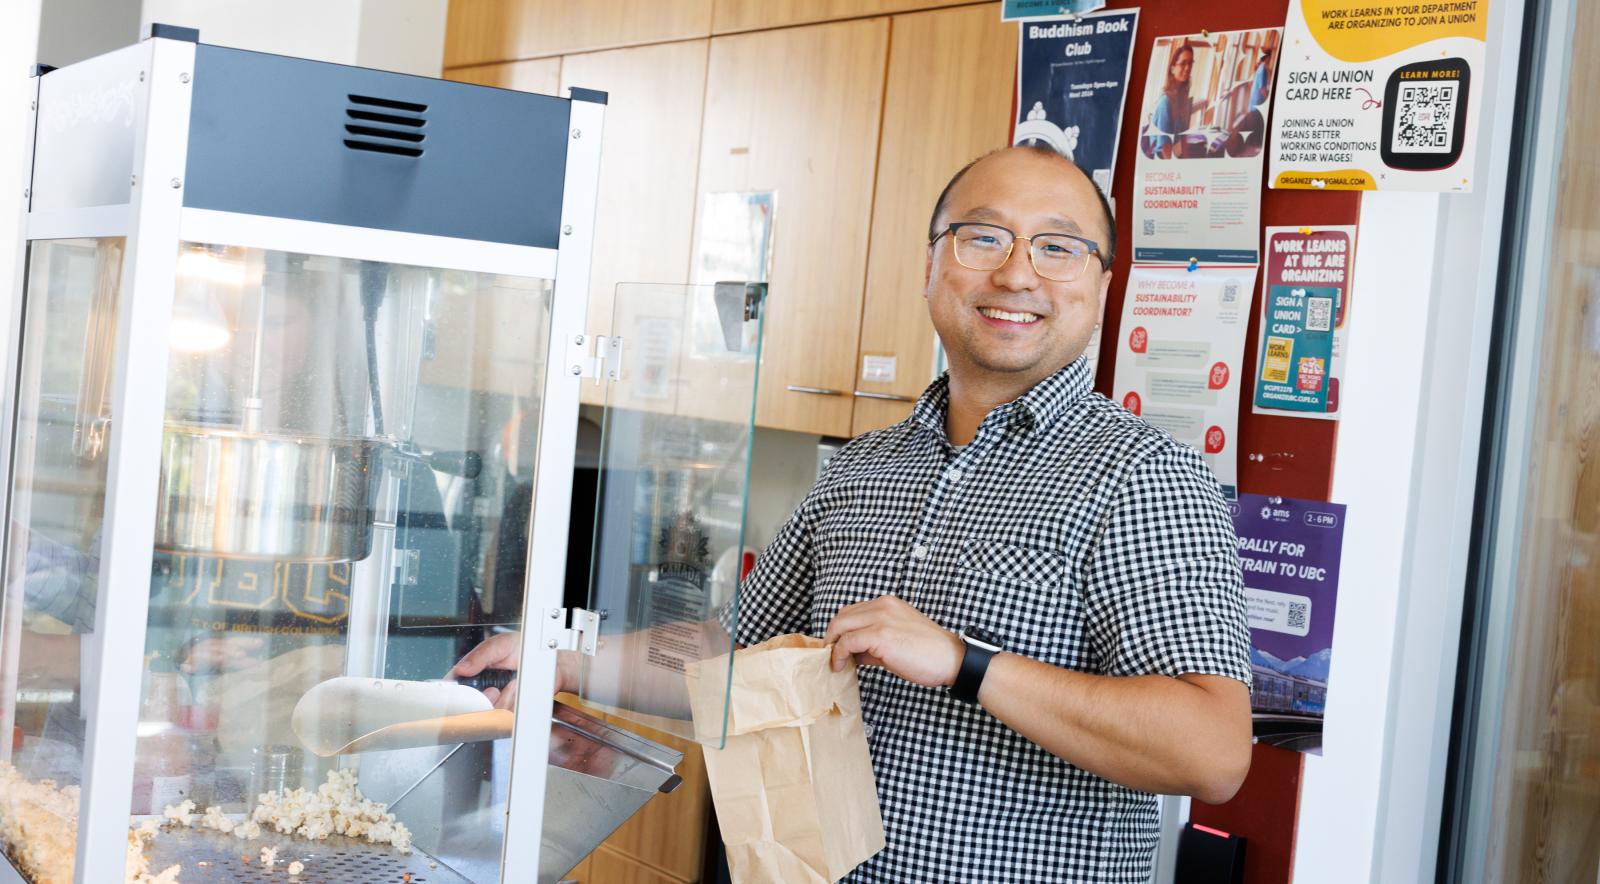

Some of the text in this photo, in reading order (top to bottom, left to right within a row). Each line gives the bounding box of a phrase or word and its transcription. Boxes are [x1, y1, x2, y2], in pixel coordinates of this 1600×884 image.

[1322, 1, 1477, 19] WORK LEARNS IN YOUR DEPARTMENT
[1327, 14, 1476, 30] ARE ORGANIZING TO JOIN A UNION
[1029, 18, 1129, 39] Buddhism Book
[1065, 41, 1092, 57] Club
[1288, 70, 1374, 84] SIGN A UNION
[1400, 69, 1460, 79] LEARN MORE!
[1286, 87, 1353, 101] CARD HERE
[1282, 119, 1354, 128] JOINING A UNION
[1281, 130, 1341, 139] MEANS BETTER
[1280, 142, 1377, 151] WORKING CONDITIONS
[1279, 153, 1353, 162] AND FAIR WAGES!
[1144, 172, 1182, 182] BECOME A
[1280, 177, 1366, 186] ORGANIZE@GMAIL.COM
[1144, 186, 1206, 195] SUSTAINABILITY
[1143, 200, 1198, 209] COORDINATOR
[1274, 240, 1347, 253] WORK LEARNS
[1284, 255, 1345, 268] AT UBC ARE
[1281, 269, 1344, 283] ORGANIZING
[1138, 280, 1196, 290] WHY BECOME A
[1135, 294, 1197, 303] SUSTAINABILITY
[1275, 296, 1303, 307] SIGN A
[1133, 307, 1193, 317] COORDINATOR?
[1274, 311, 1301, 321] UNION
[1272, 323, 1294, 334] CARD
[1268, 344, 1286, 352] WORK
[1267, 350, 1289, 359] LEARNS
[1272, 508, 1290, 518] ams
[1322, 515, 1334, 525] PM
[1238, 536, 1306, 557] RALLY FOR
[1280, 562, 1297, 577] TO
[1298, 565, 1327, 581] UBC
